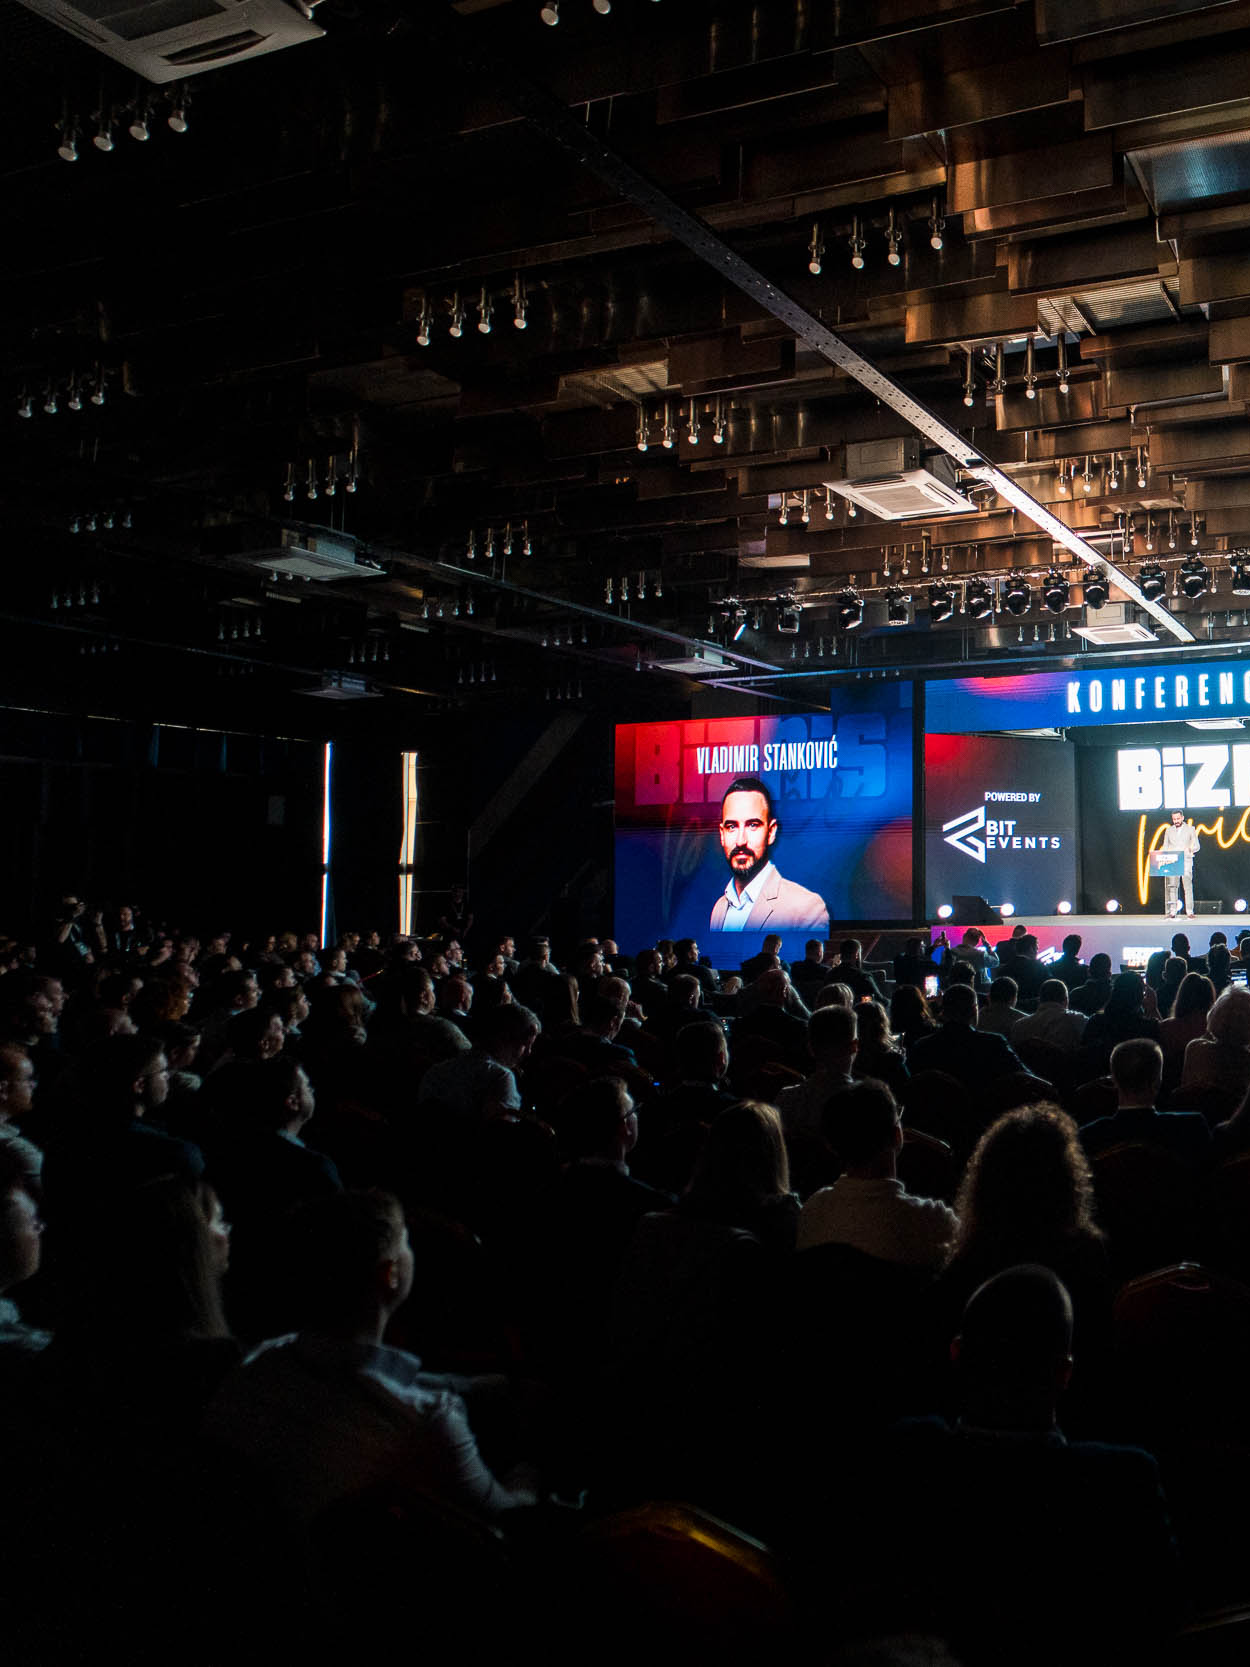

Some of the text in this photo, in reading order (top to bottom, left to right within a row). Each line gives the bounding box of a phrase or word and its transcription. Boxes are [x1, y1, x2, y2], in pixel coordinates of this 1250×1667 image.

[697, 734, 838, 774] VLADIMIR STANKOVIĆ
[984, 792, 1041, 803] POWERED BY
[986, 820, 1016, 836] BIT
[986, 836, 1061, 849] EVENTS
